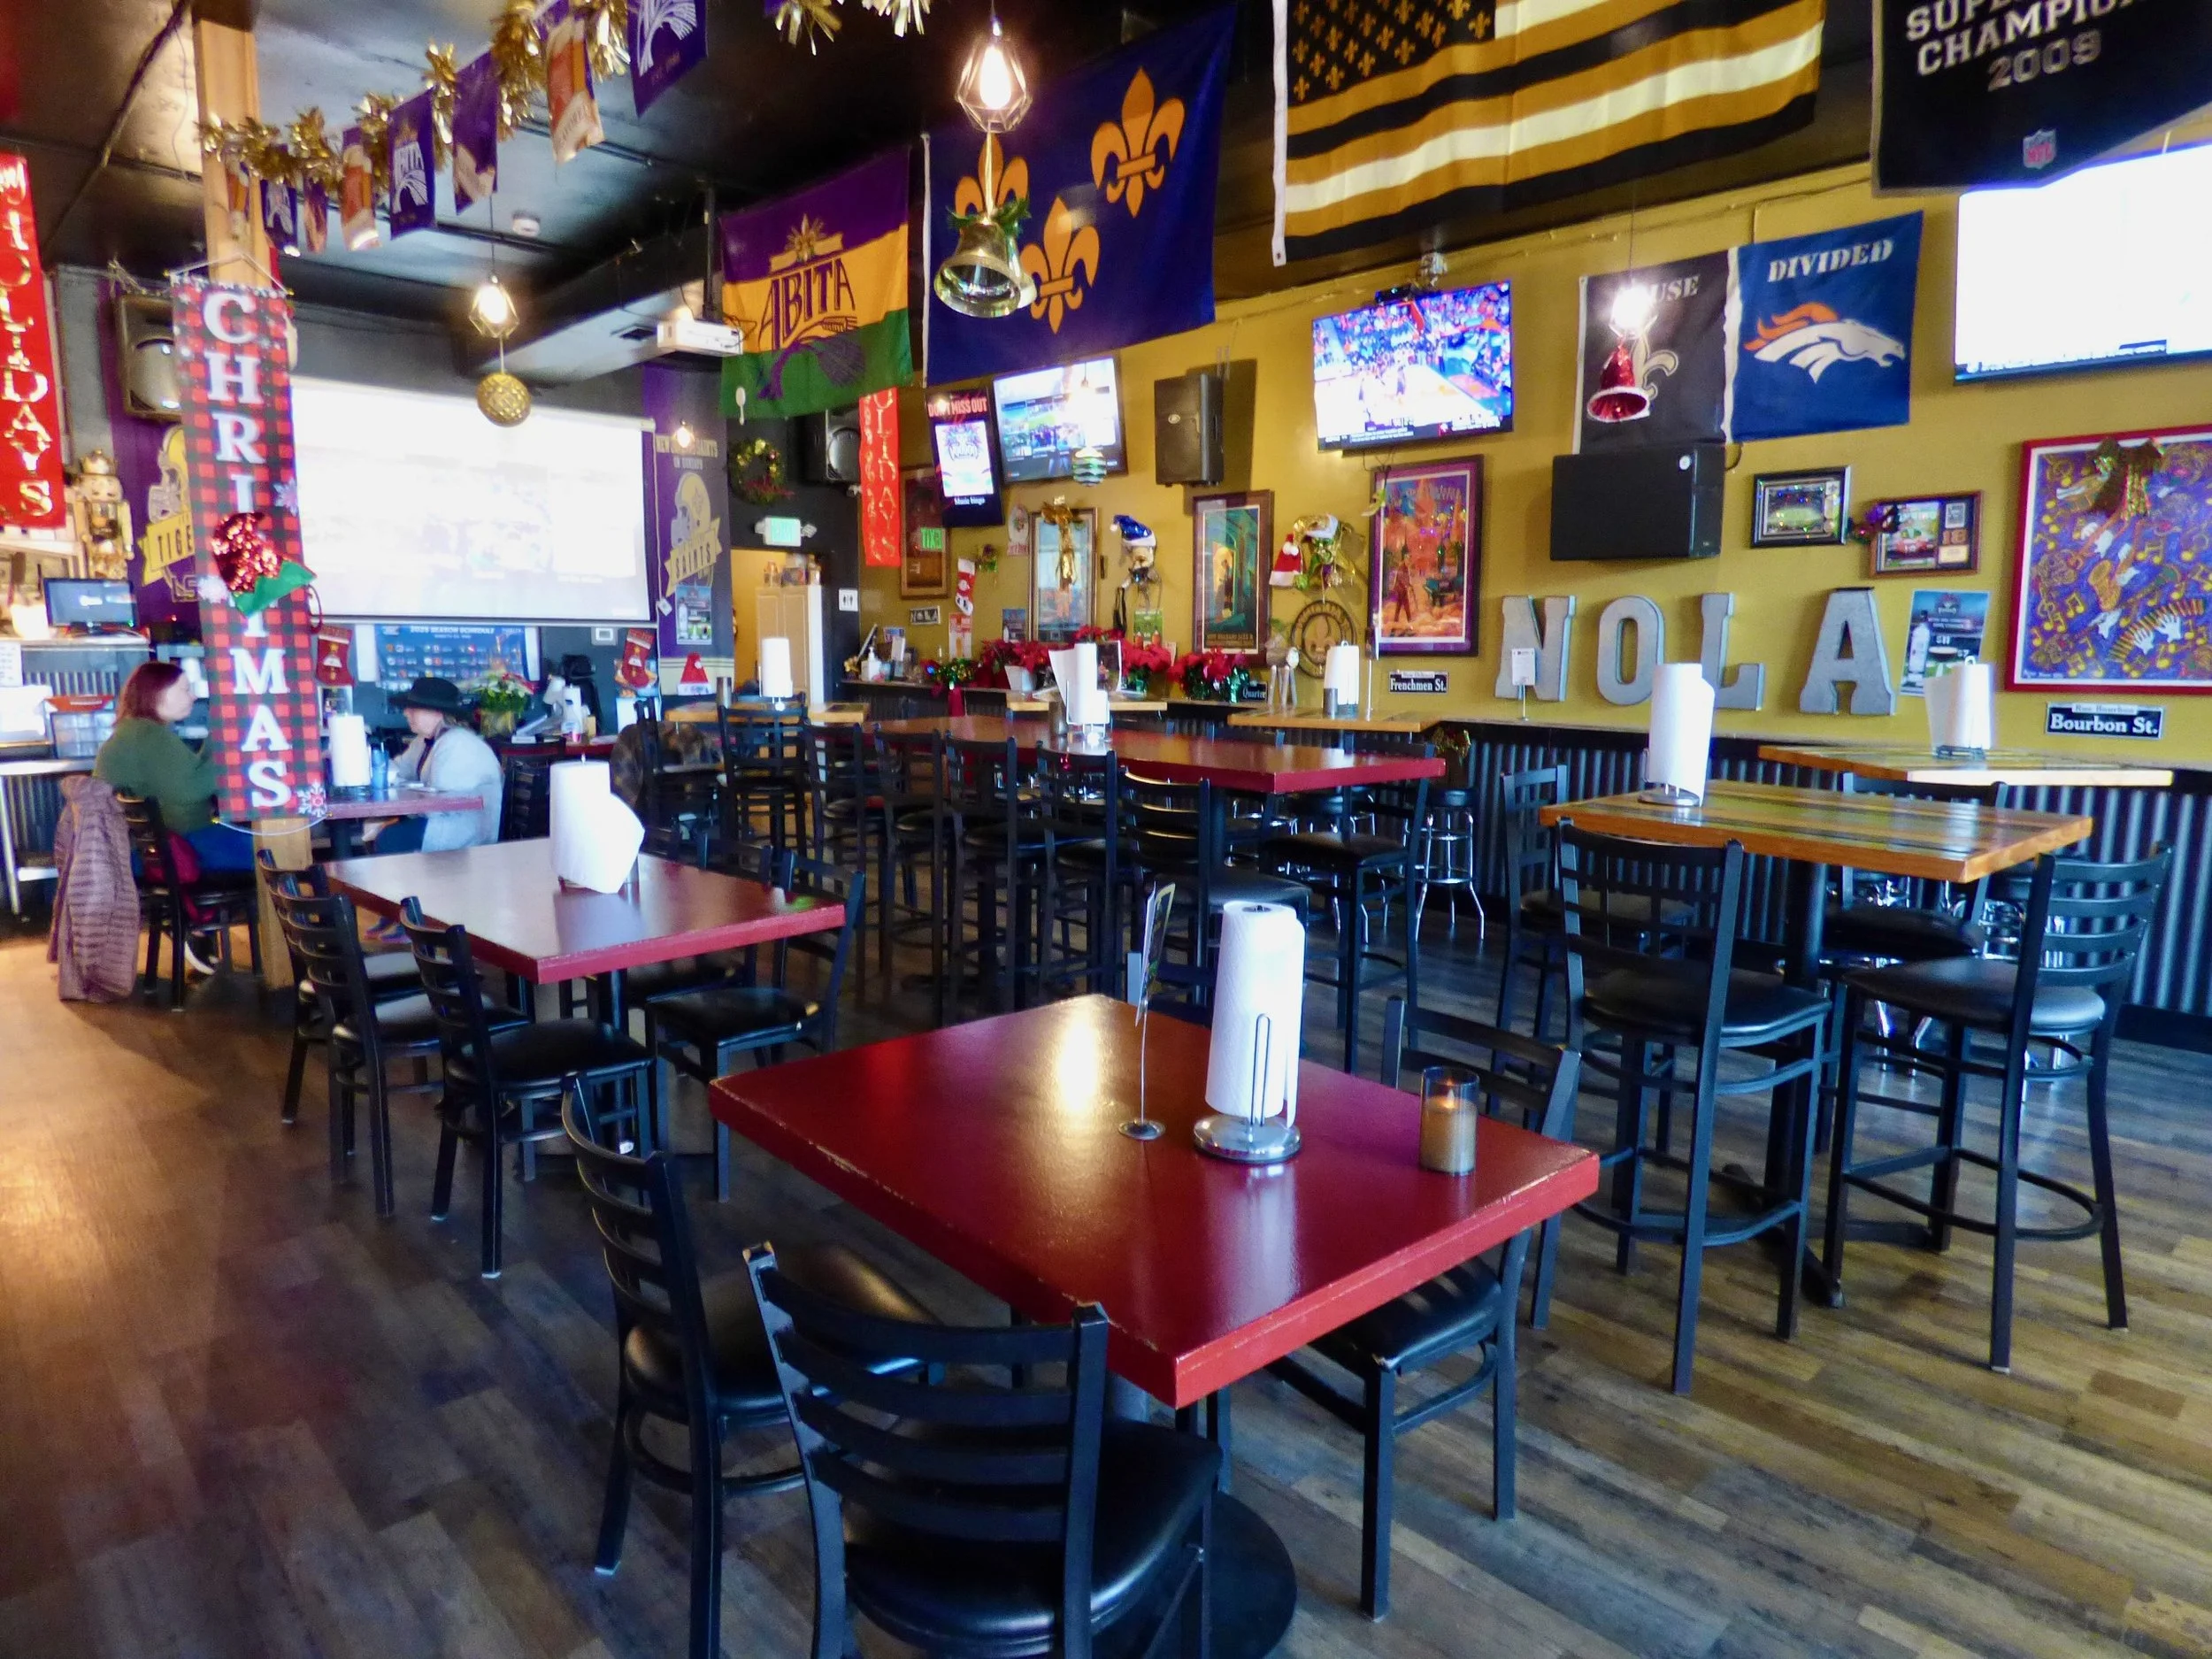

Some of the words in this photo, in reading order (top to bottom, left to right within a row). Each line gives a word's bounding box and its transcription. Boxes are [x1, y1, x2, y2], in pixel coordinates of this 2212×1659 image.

[1768, 239, 1893, 282] DIVIDED
[758, 257, 856, 351] ABITA
[972, 396, 987, 413] OUT
[157, 525, 191, 563] TIGE
[675, 541, 711, 580] SAINTS
[1494, 588, 1895, 716] NOLA
[1390, 678, 1433, 691] Frenchmen
[1435, 678, 1447, 692] St.
[2050, 713, 2127, 733] Bourbon
[2132, 717, 2159, 735] St.
